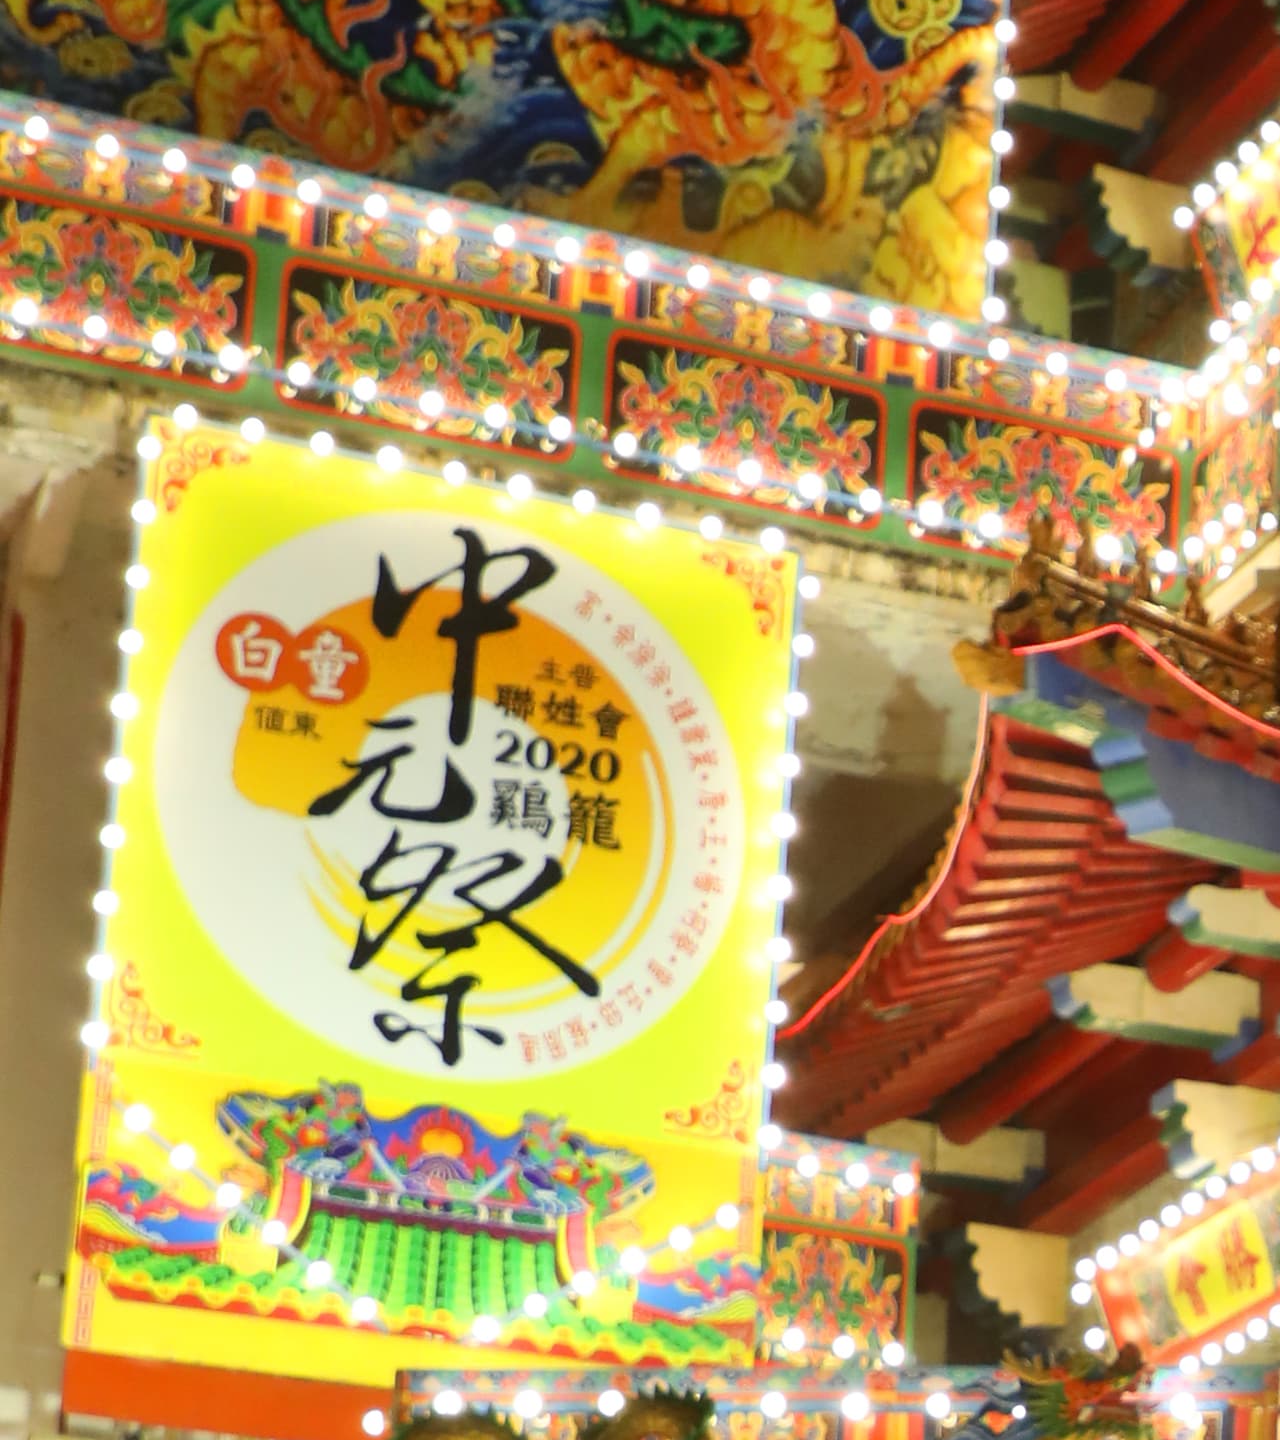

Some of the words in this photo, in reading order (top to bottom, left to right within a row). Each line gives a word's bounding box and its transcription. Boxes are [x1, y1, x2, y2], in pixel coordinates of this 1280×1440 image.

[229, 622, 359, 701] 白童
[536, 658, 598, 689] 主普
[495, 685, 628, 740] 聯姓會
[495, 730, 621, 783] 2020
[307, 526, 602, 1067] 中元祭
